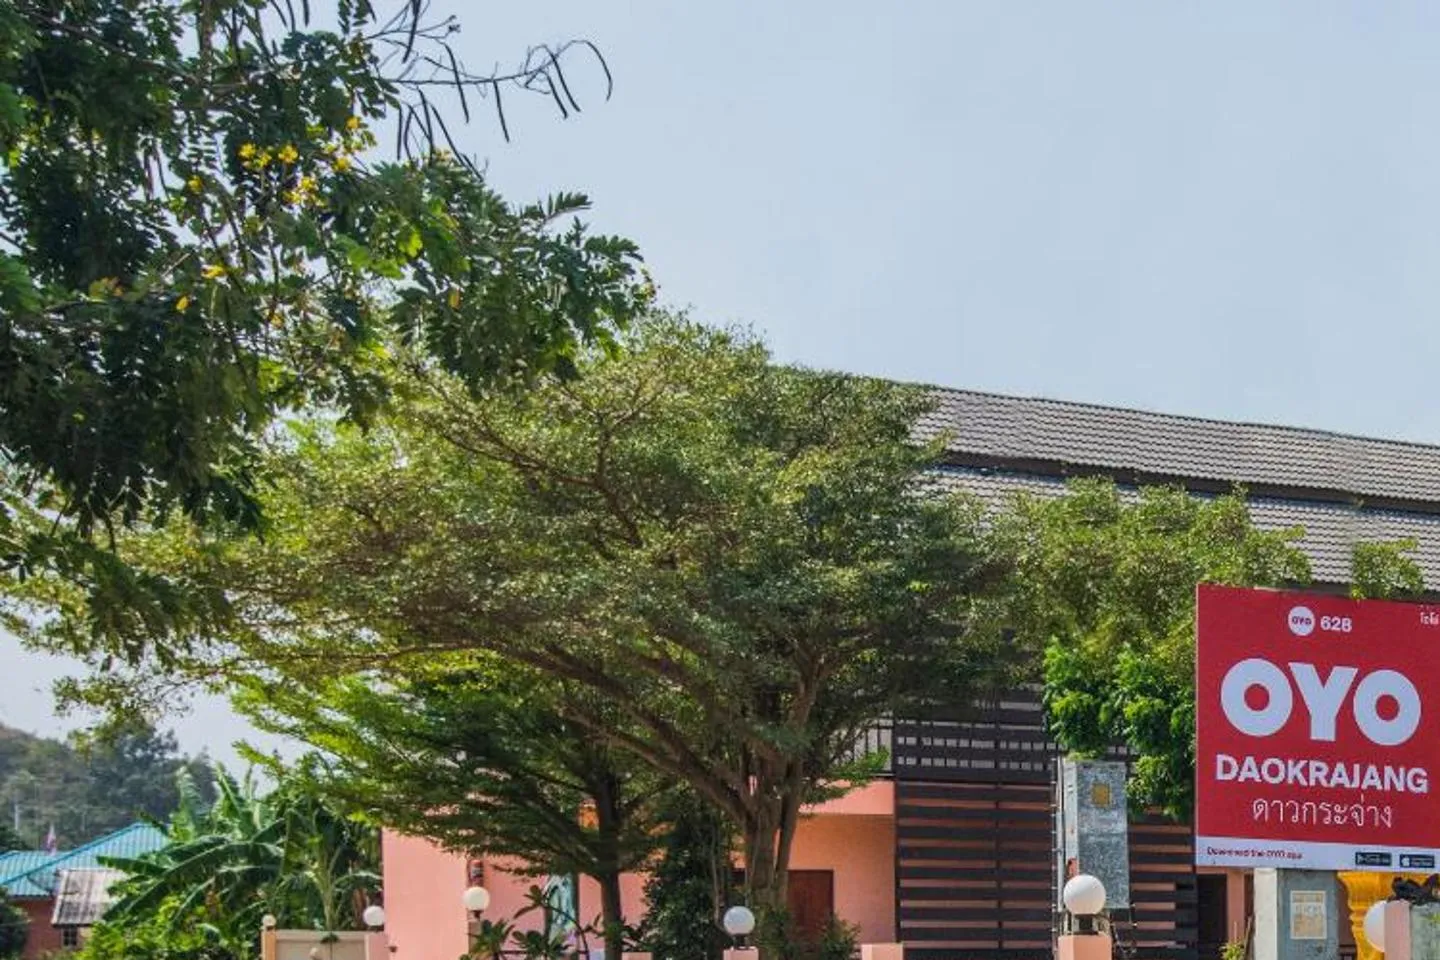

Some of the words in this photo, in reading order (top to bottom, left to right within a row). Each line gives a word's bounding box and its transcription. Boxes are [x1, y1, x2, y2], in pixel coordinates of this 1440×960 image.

[1220, 657, 1422, 746] OYO
[1215, 754, 1429, 794] DAOKRAJANG
[1253, 793, 1392, 828] ดาวกระจ่าง
